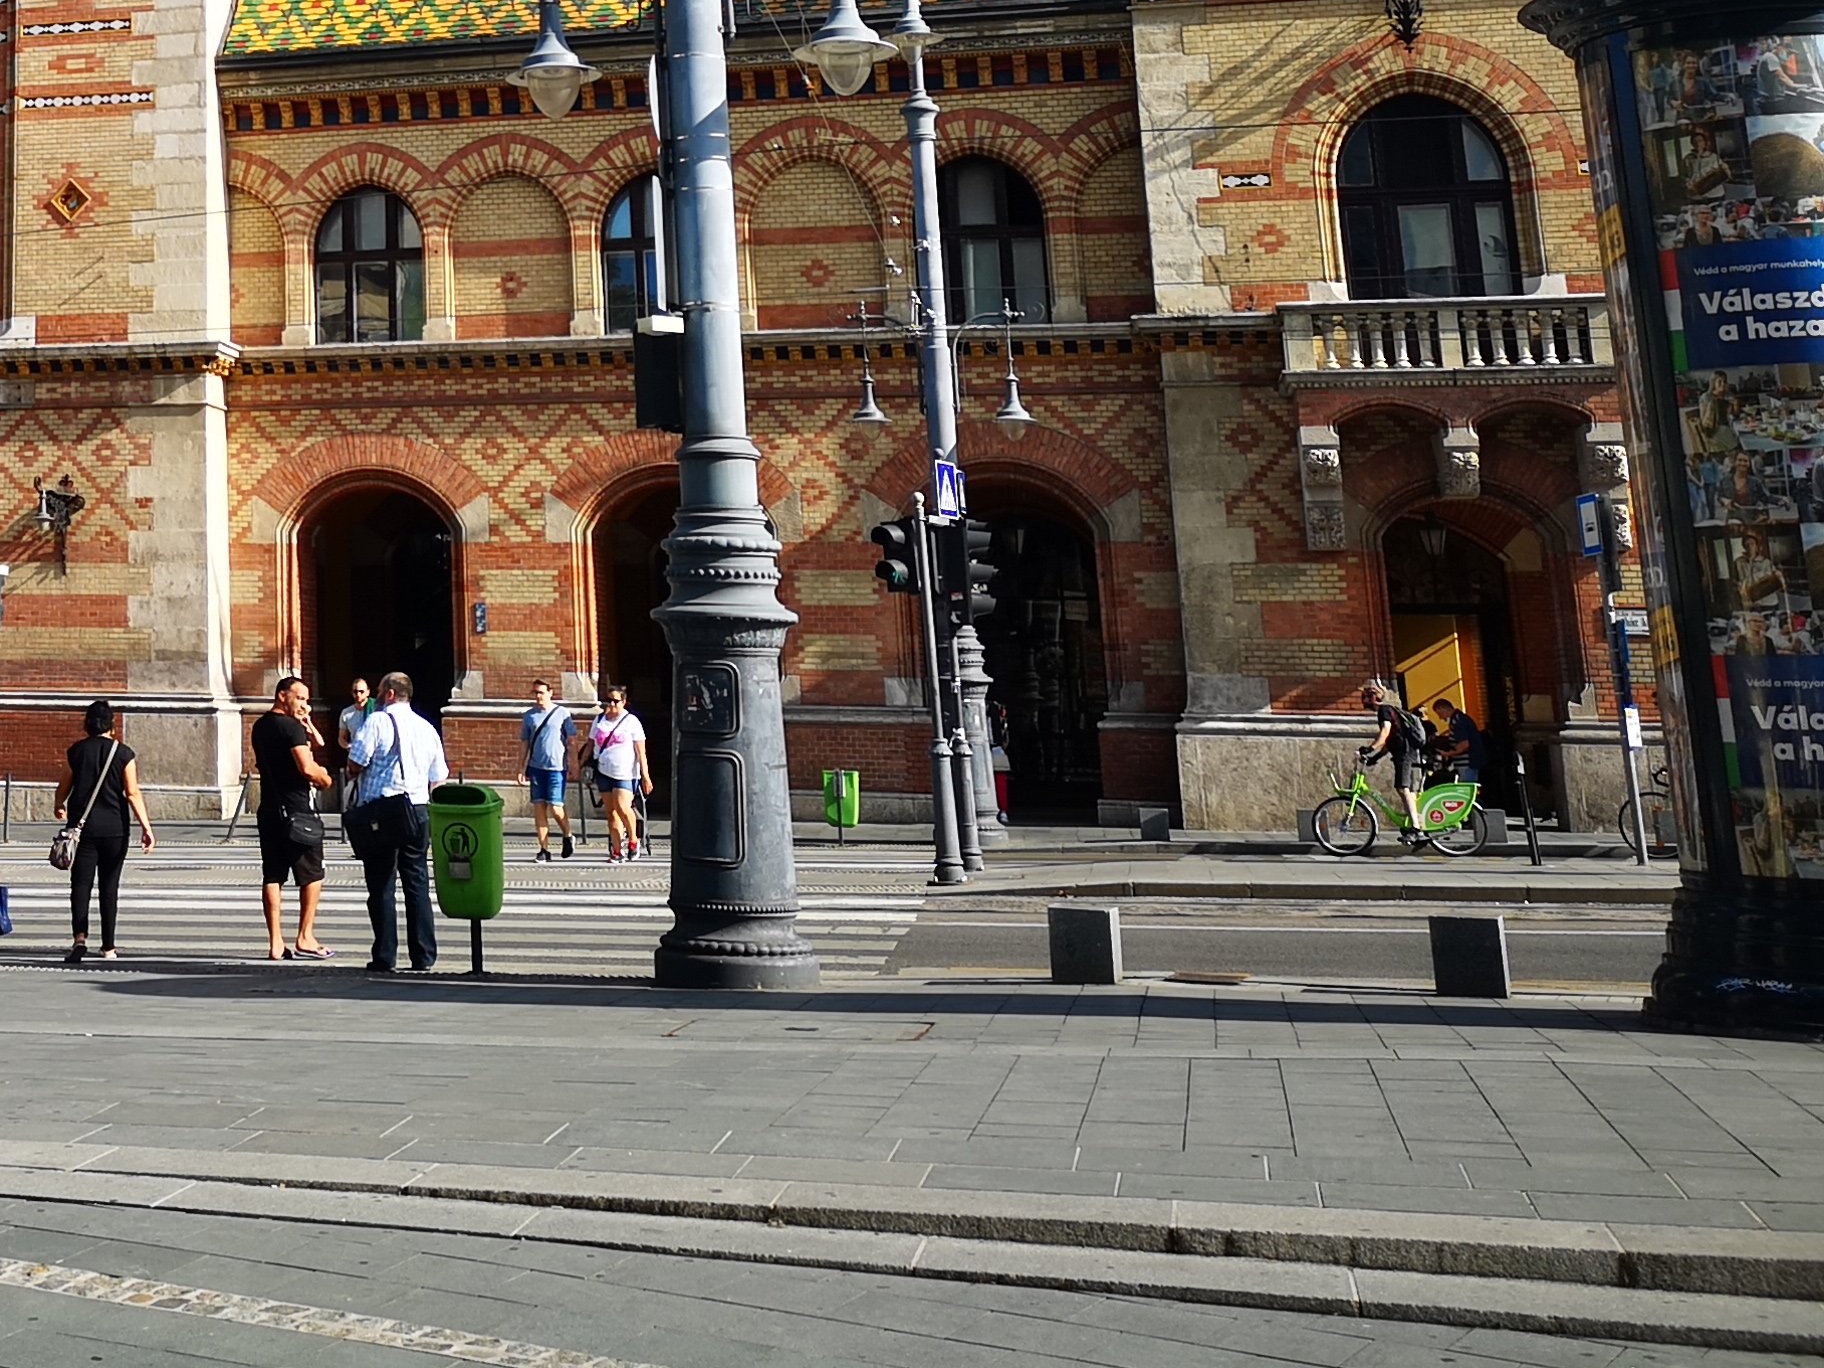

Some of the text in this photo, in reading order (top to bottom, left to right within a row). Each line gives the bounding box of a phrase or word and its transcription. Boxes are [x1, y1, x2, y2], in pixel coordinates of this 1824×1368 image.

[1693, 265, 1719, 277] Védd
[1729, 262, 1768, 274] magyar
[1718, 324, 1740, 342] a
[1773, 741, 1795, 761] a
